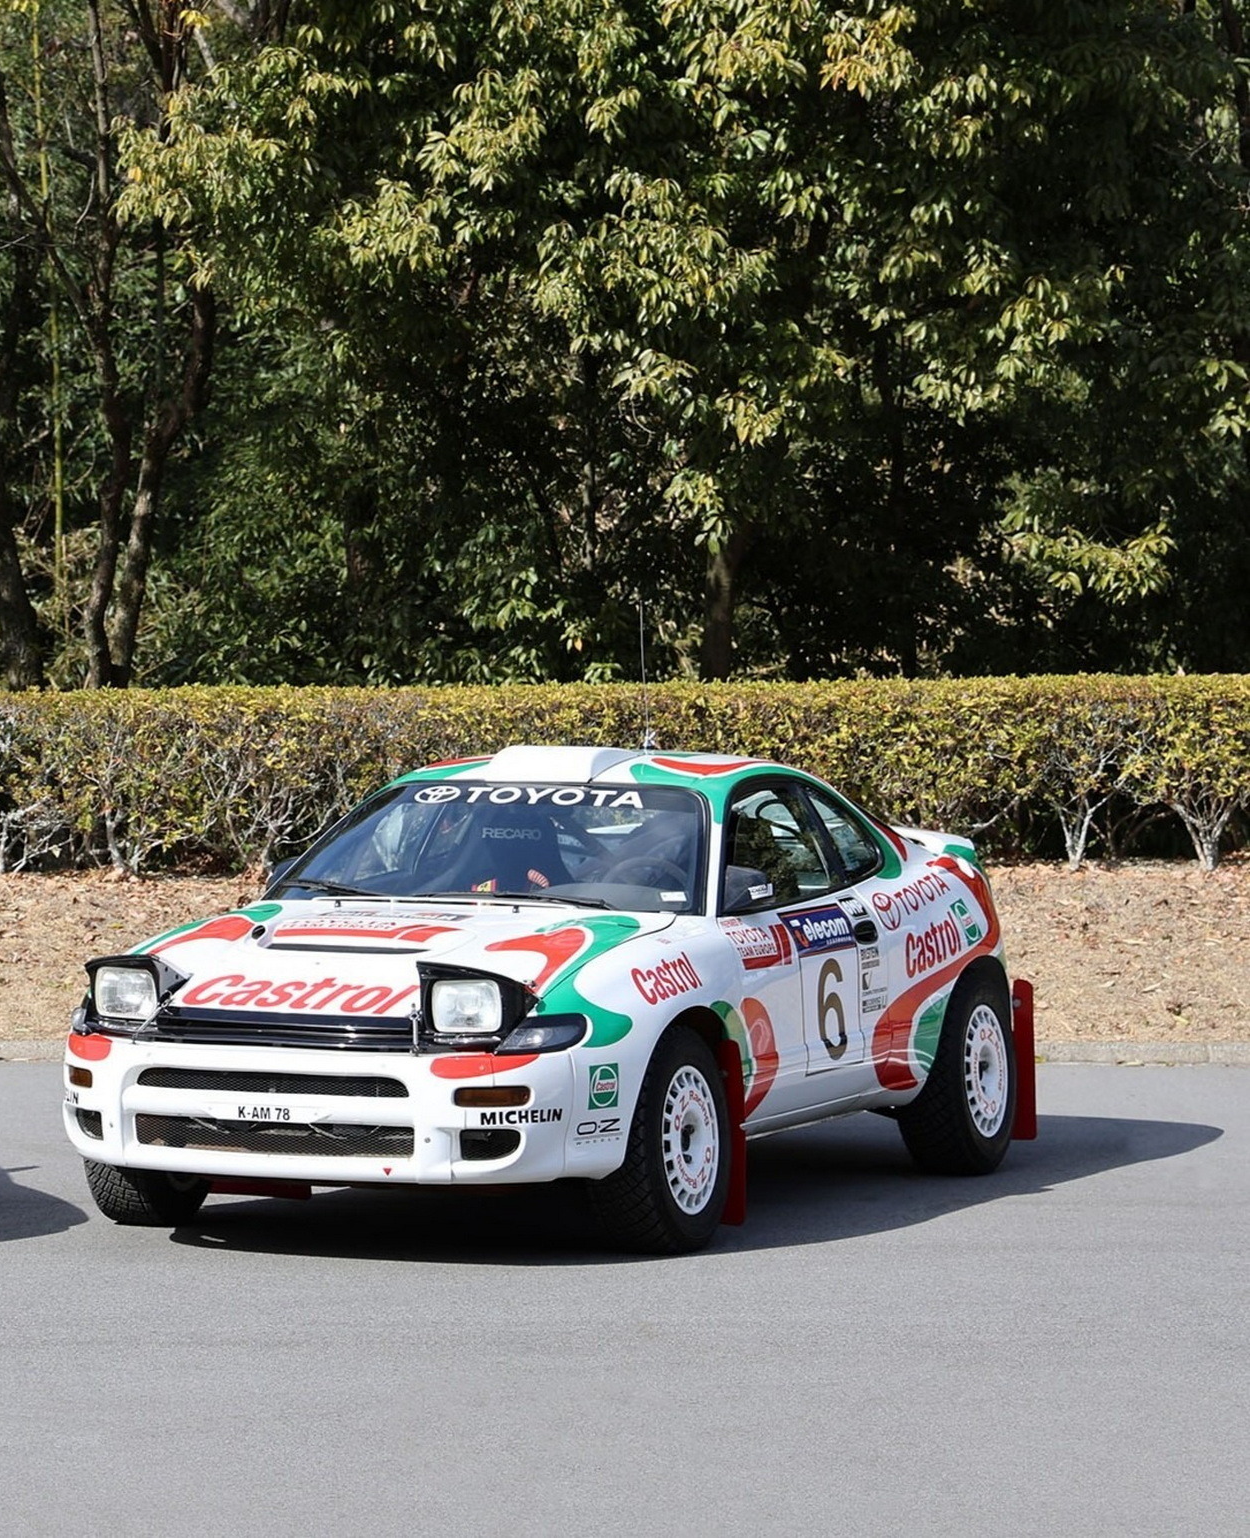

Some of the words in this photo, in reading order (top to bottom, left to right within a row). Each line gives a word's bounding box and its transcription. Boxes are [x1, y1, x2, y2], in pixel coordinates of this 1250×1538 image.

[467, 786, 644, 809] TOYOTA
[482, 827, 541, 840] RECARO
[894, 873, 950, 915] TOYOTA
[725, 927, 770, 945] TOYOTA
[906, 911, 961, 978] Castrol
[737, 946, 754, 957] TEAM
[753, 943, 777, 956] EUROPE
[631, 951, 703, 1005] Castrol
[182, 974, 421, 1015] Castrol
[818, 958, 848, 1060] 6
[238, 1106, 271, 1121] K-AM
[275, 1107, 291, 1121] 78
[480, 1108, 563, 1126] MICHELIN
